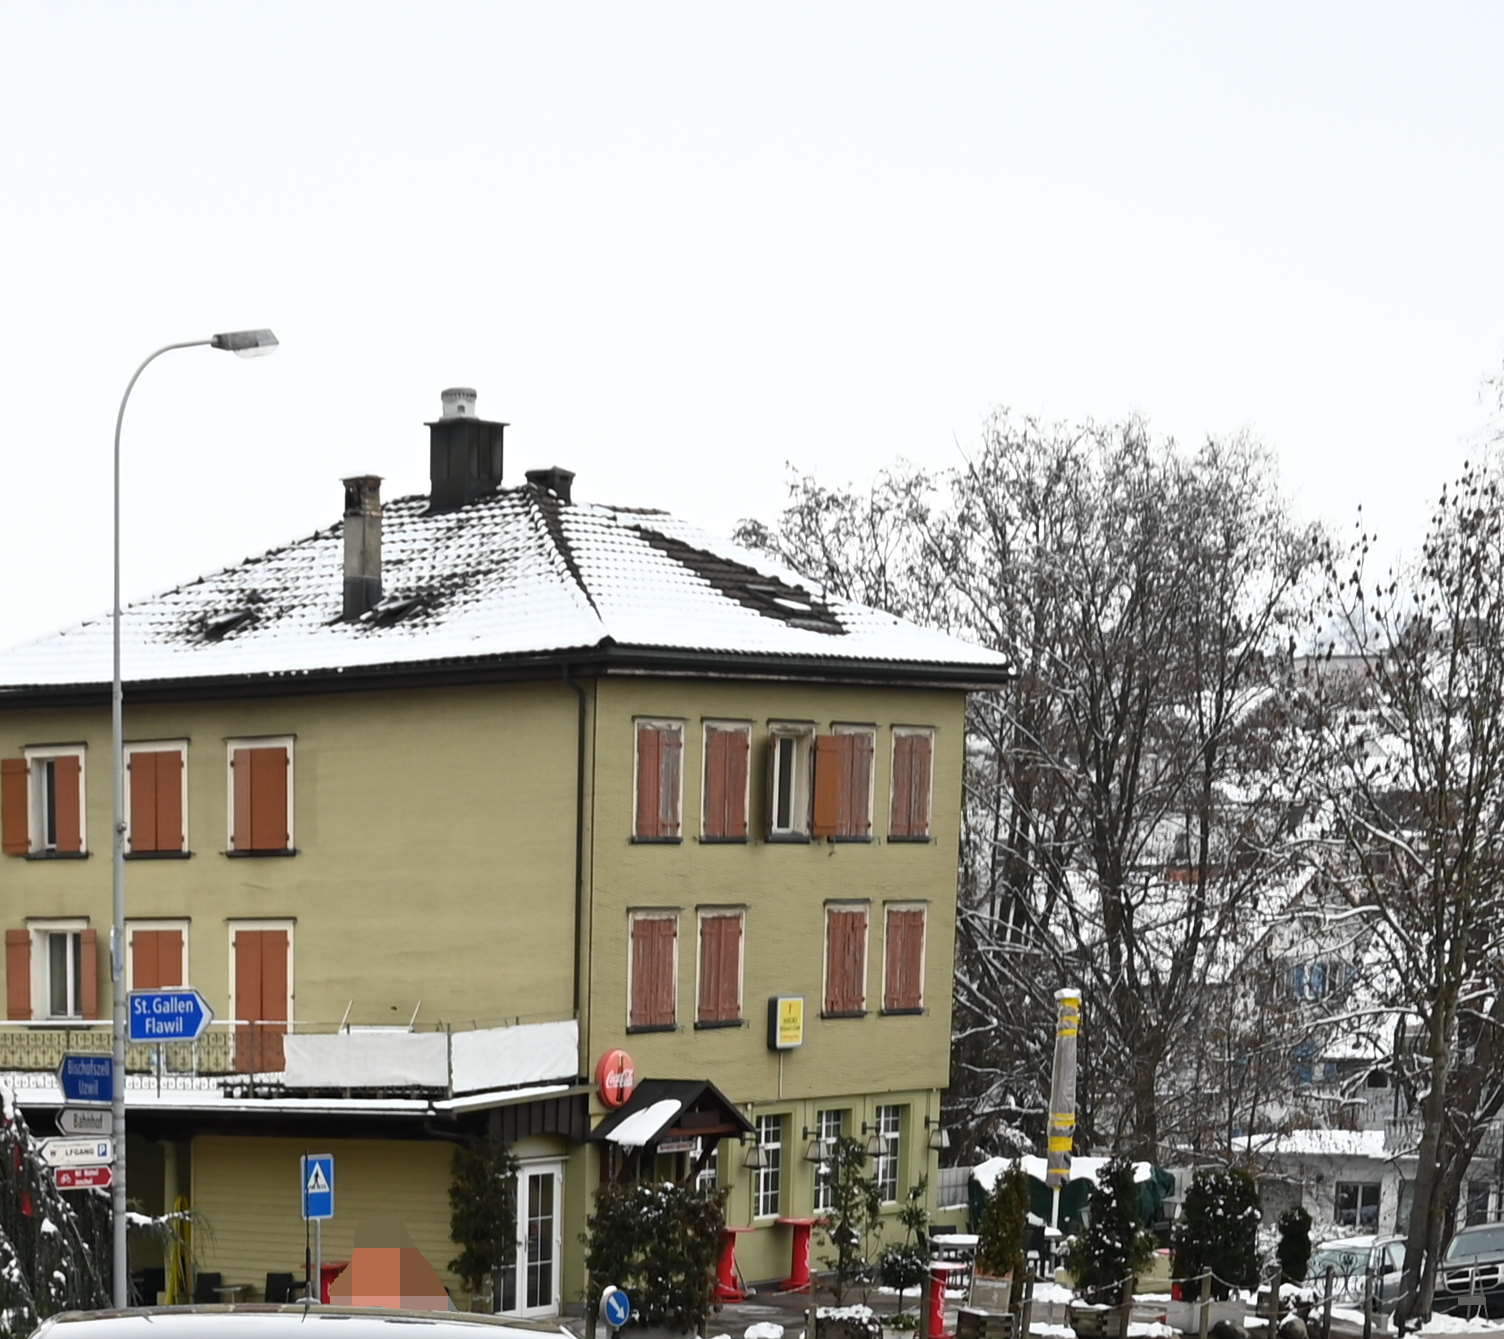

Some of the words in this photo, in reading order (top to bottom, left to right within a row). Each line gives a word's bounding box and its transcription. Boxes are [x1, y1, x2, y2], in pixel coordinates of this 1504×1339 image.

[134, 998, 152, 1014] St.
[152, 996, 194, 1014] Gallen
[145, 1017, 184, 1034] Flawil
